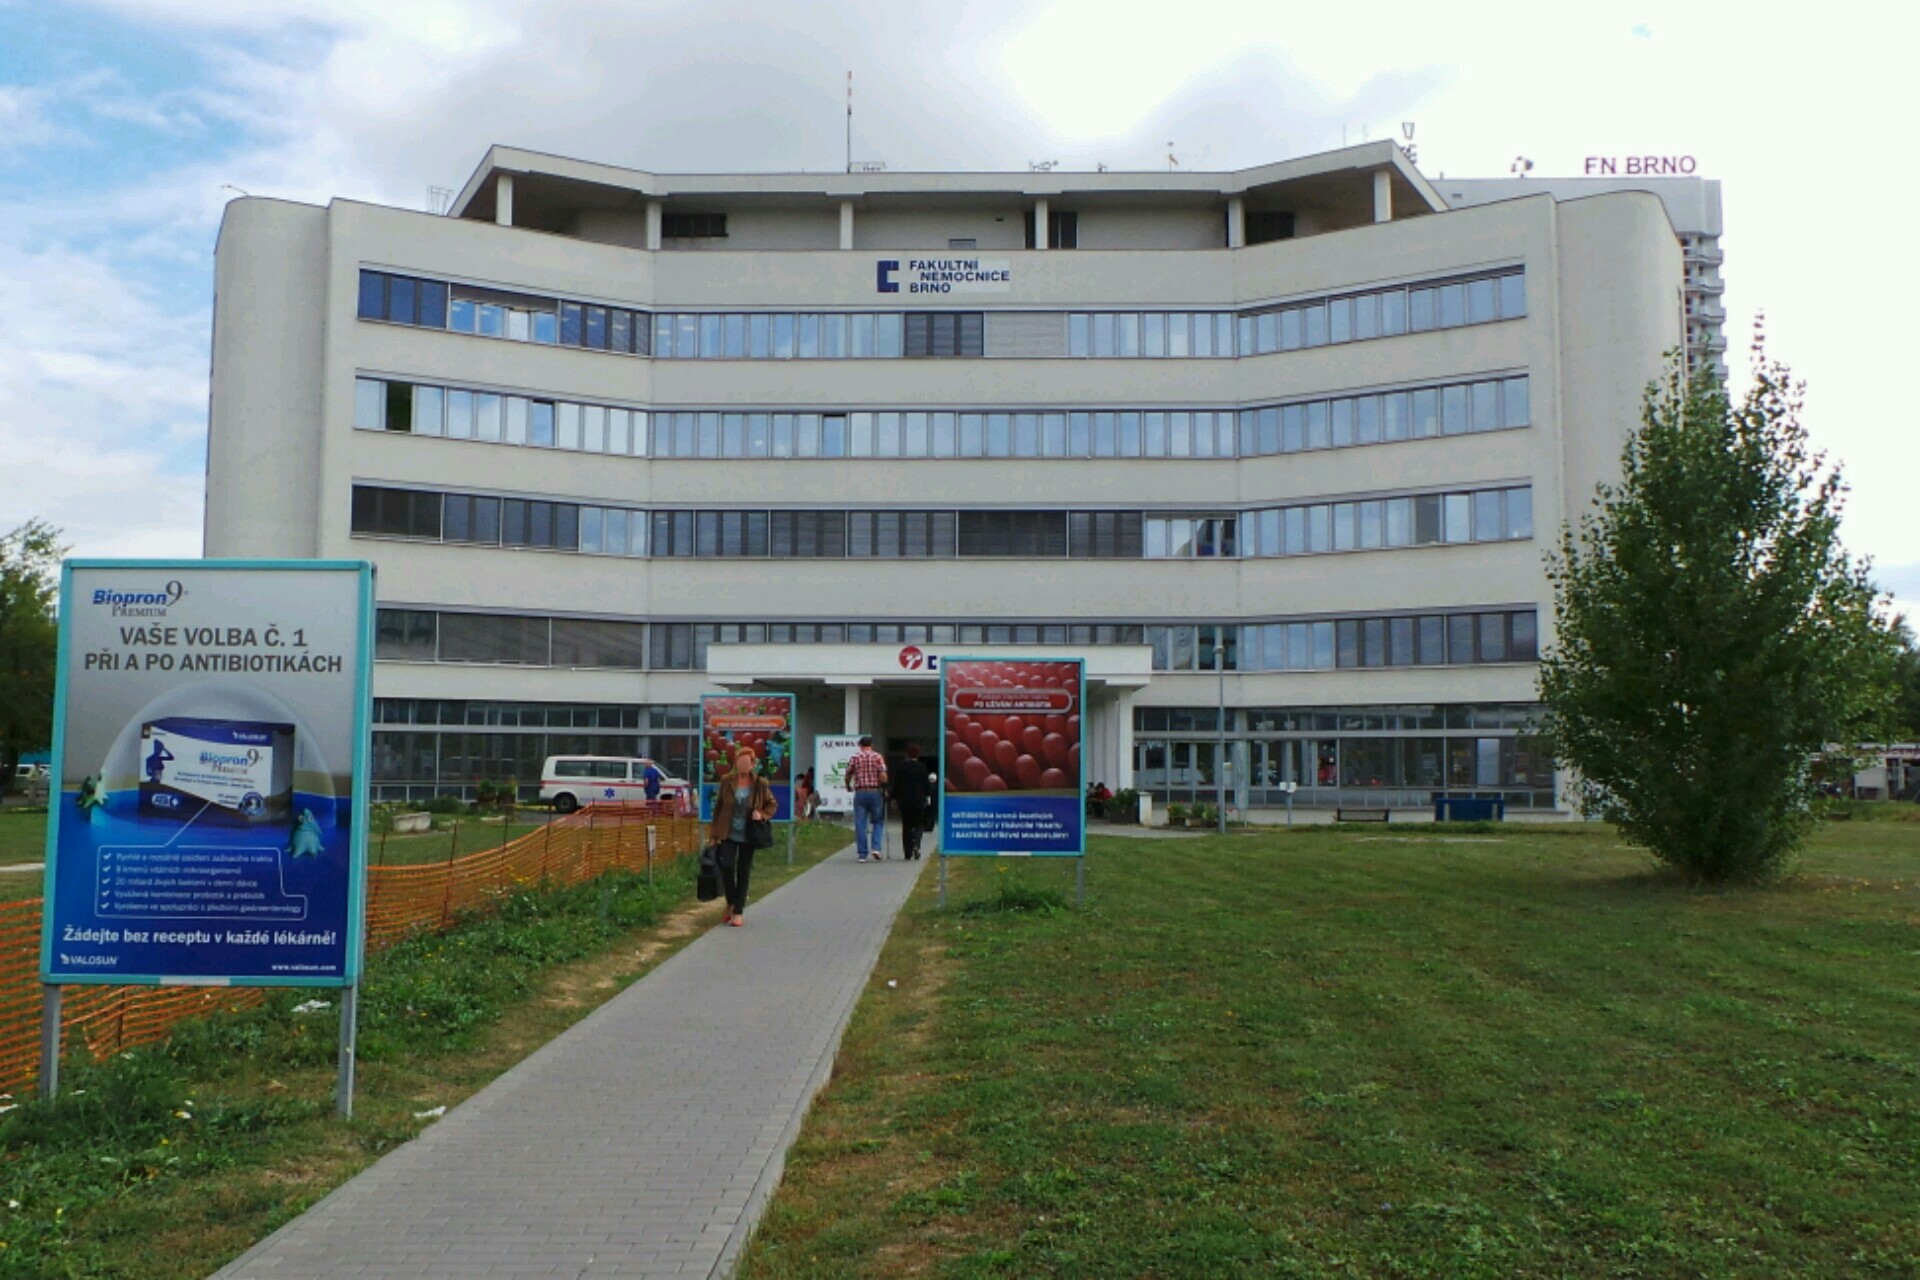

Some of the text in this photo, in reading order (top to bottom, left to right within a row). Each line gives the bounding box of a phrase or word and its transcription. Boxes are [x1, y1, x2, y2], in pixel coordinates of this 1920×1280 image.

[1585, 156, 1697, 174] FN BRNO
[920, 271, 1010, 282] NEMOCNICE
[909, 282, 951, 294] BRNO
[120, 622, 308, 647] VAŠE VOLBA Č. 1
[84, 648, 343, 673] PŘI A PO ANTIBIOTIKÁCH
[63, 924, 337, 946] Žádejte bez receptu v každé lékárně!
[70, 955, 118, 965] VALOSUN
